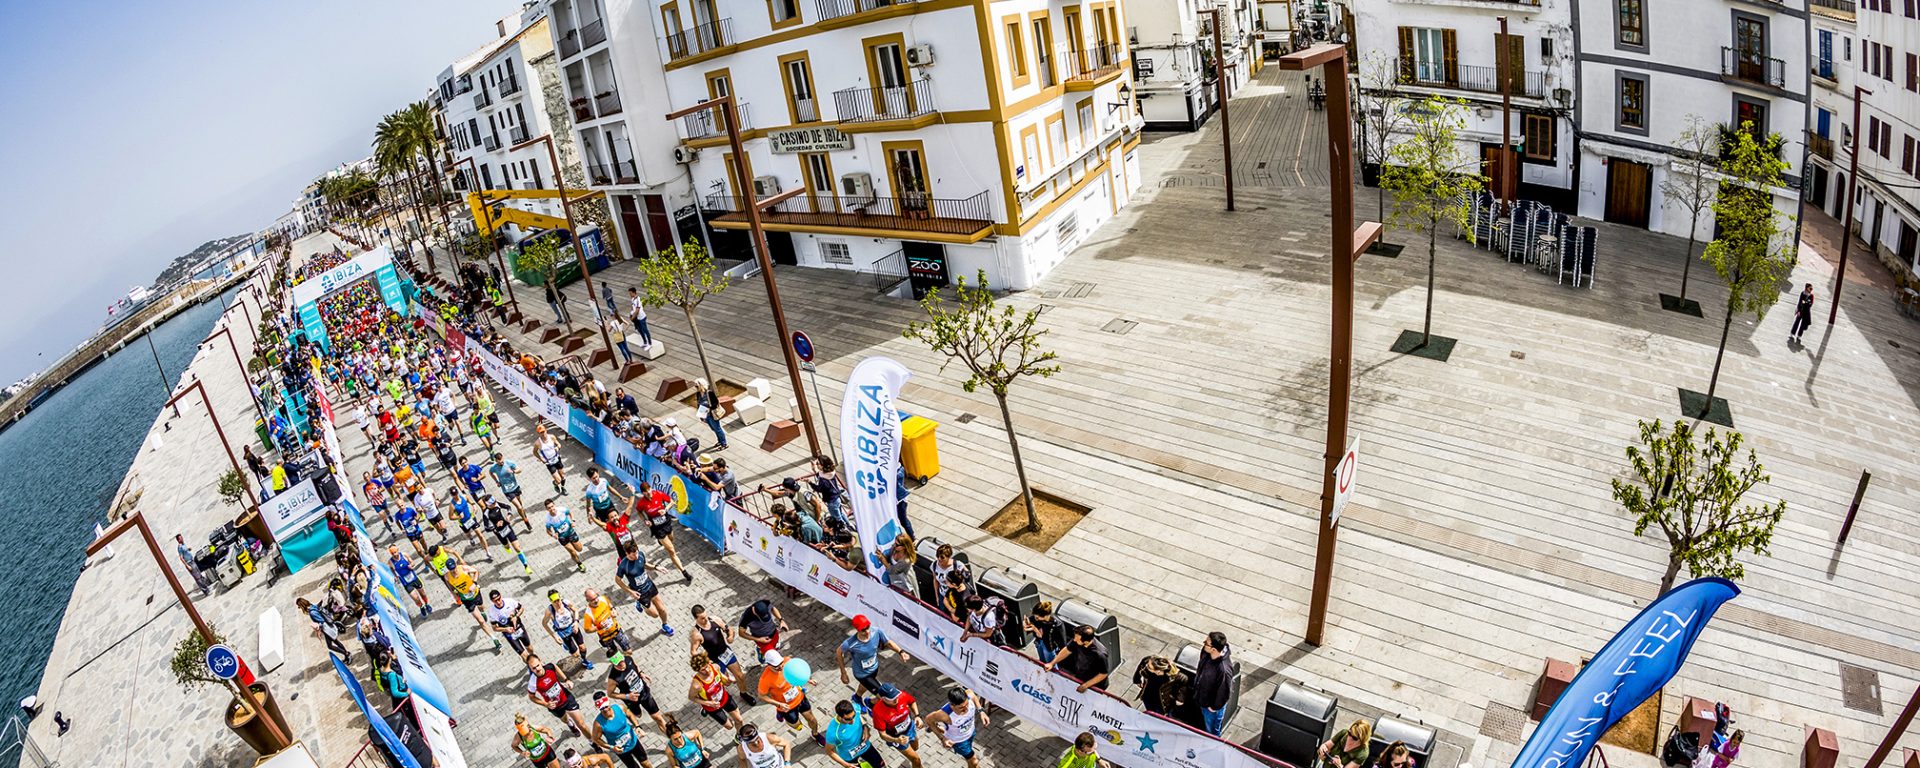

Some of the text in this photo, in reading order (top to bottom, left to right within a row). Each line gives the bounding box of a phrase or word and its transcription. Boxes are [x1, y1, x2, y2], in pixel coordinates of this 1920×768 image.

[779, 128, 847, 146] CASINO DE IBIZA
[333, 263, 362, 282] IBIZA
[910, 260, 940, 271] ZOO
[858, 385, 883, 465] IBIZA
[880, 395, 895, 470] MARATHO
[615, 452, 649, 483] AMSTEL
[288, 489, 315, 509] IBIZA
[1593, 682, 1625, 707] &
[1613, 608, 1698, 676] FEEL
[1058, 695, 1083, 725] STK
[1091, 710, 1123, 731] AMSTEL
